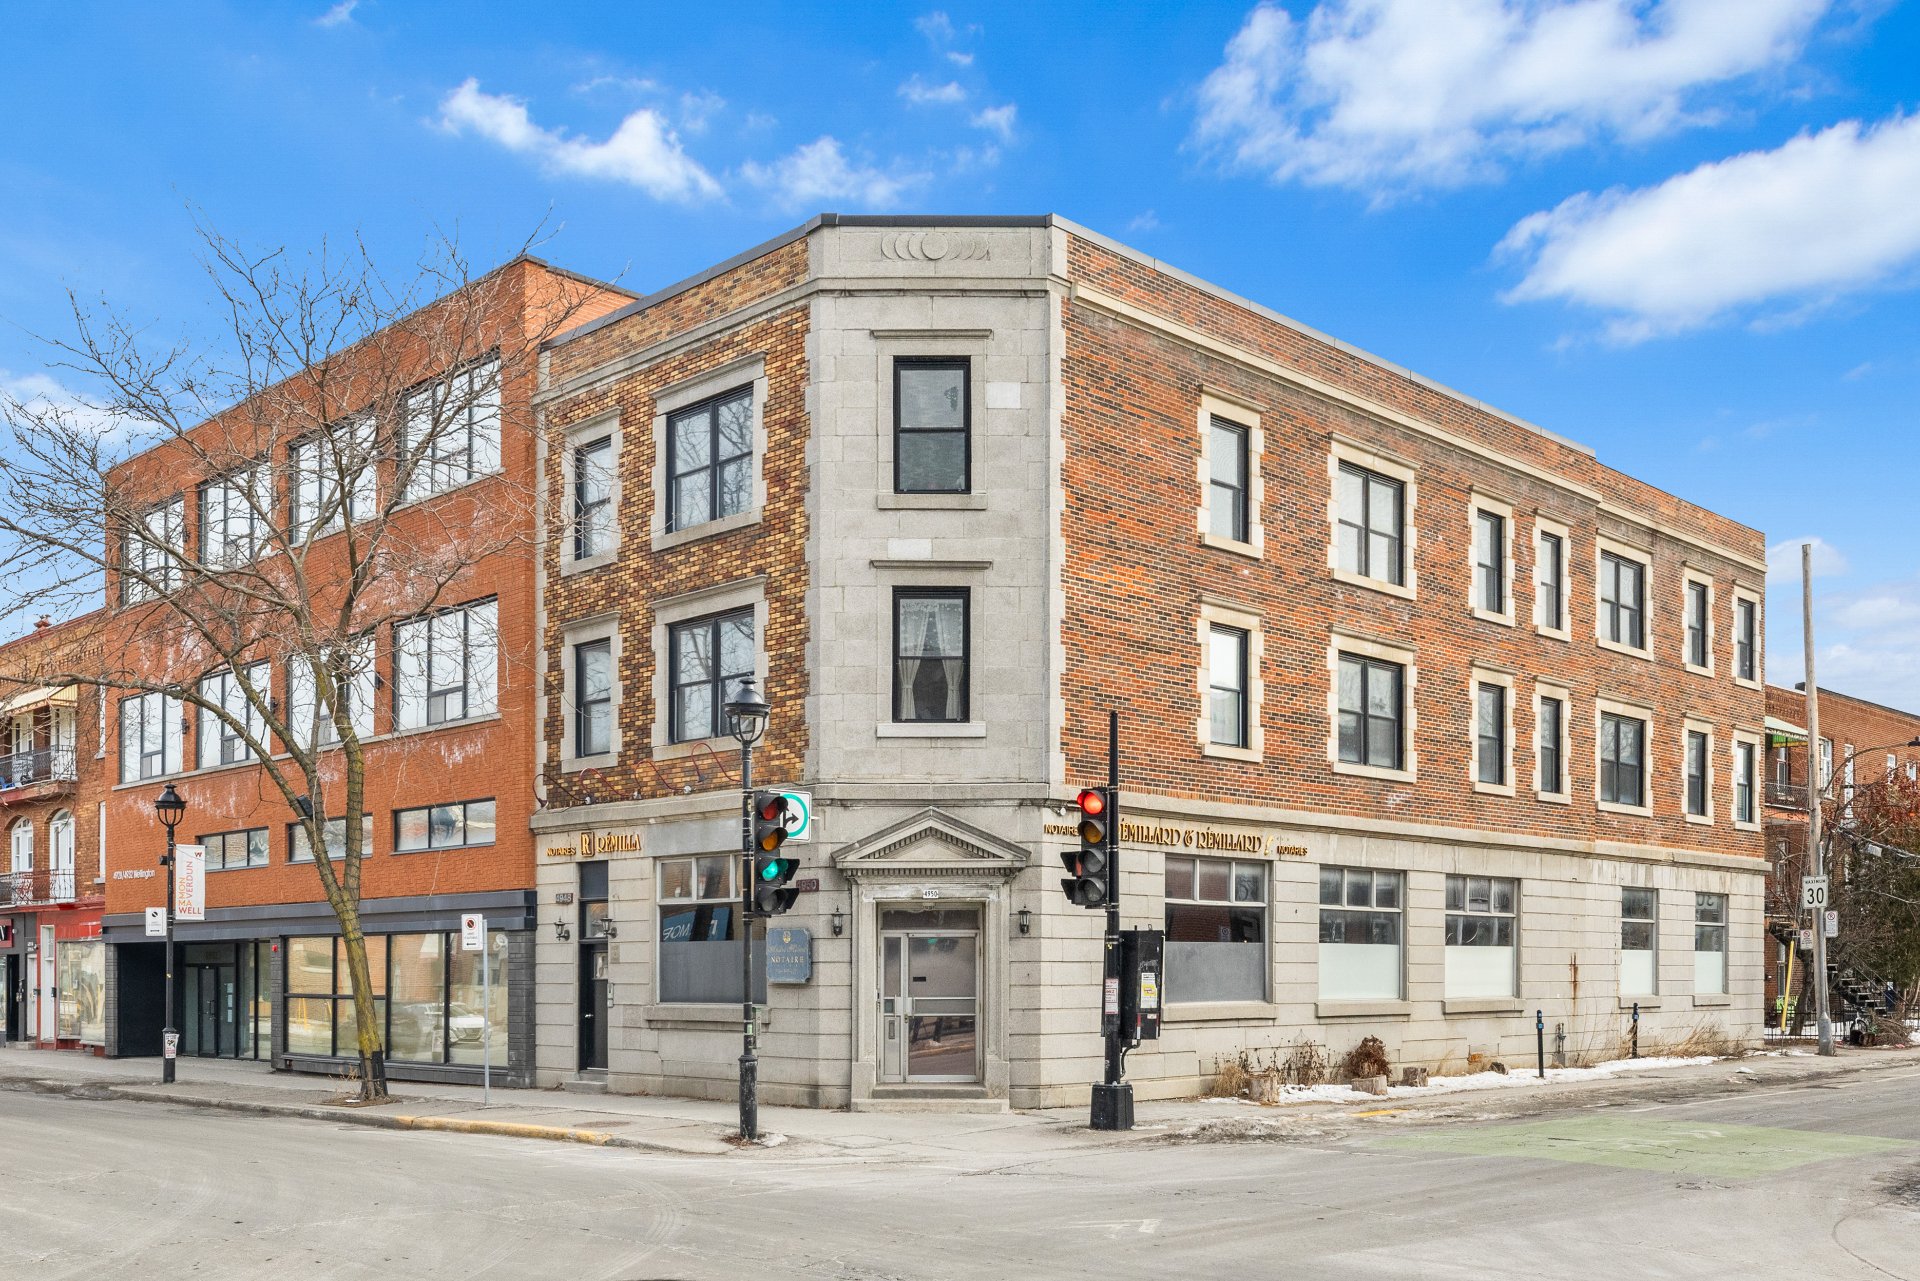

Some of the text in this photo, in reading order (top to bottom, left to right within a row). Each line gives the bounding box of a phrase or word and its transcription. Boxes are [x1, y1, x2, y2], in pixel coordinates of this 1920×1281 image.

[1044, 818, 1262, 853] NOTAIRE ÉMILLARD & RÉMILLARD
[1807, 887, 1824, 905] 30
[178, 899, 192, 907] MA
[178, 907, 202, 915] WELL
[771, 955, 804, 964] NOTAIRE
